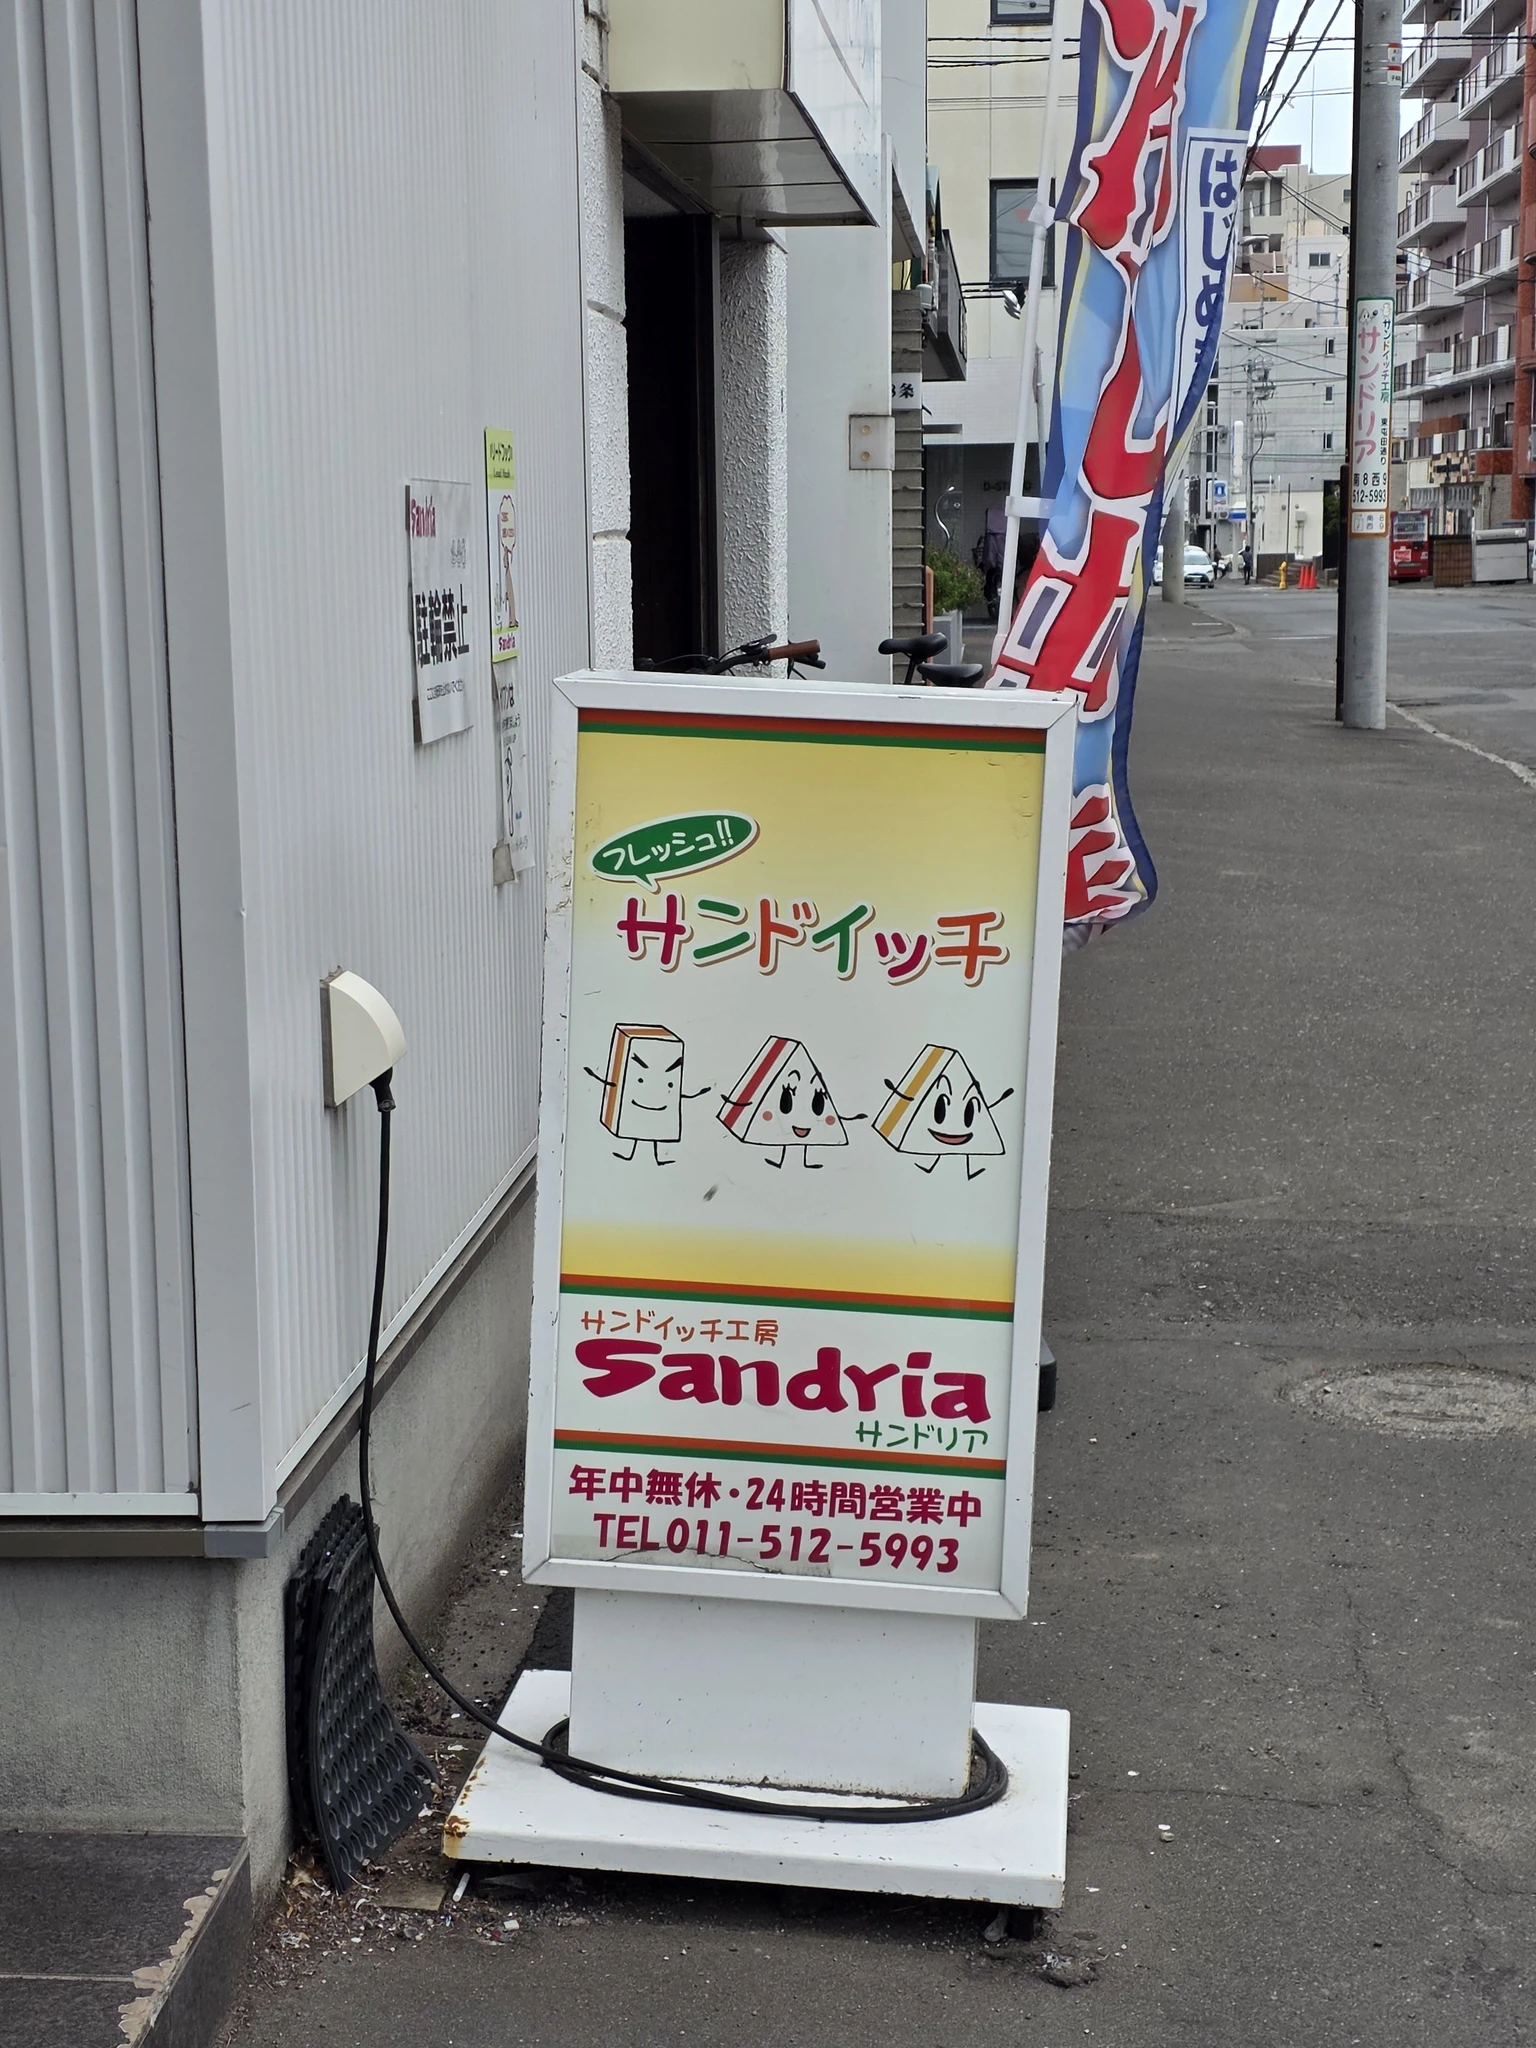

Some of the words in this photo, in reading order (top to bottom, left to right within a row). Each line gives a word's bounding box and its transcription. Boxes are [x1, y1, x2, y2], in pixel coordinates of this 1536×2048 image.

[1355, 326, 1380, 464] サンドリア
[1353, 489, 1386, 503] 512-5993
[415, 584, 469, 668] 駐輪禁止
[602, 818, 733, 873] フレッシュ!!
[616, 893, 1005, 983] サンドイッチ
[582, 1310, 779, 1347] サンドイッチ工房
[575, 1338, 991, 1424] Sandria
[856, 1421, 989, 1453] サンドリア
